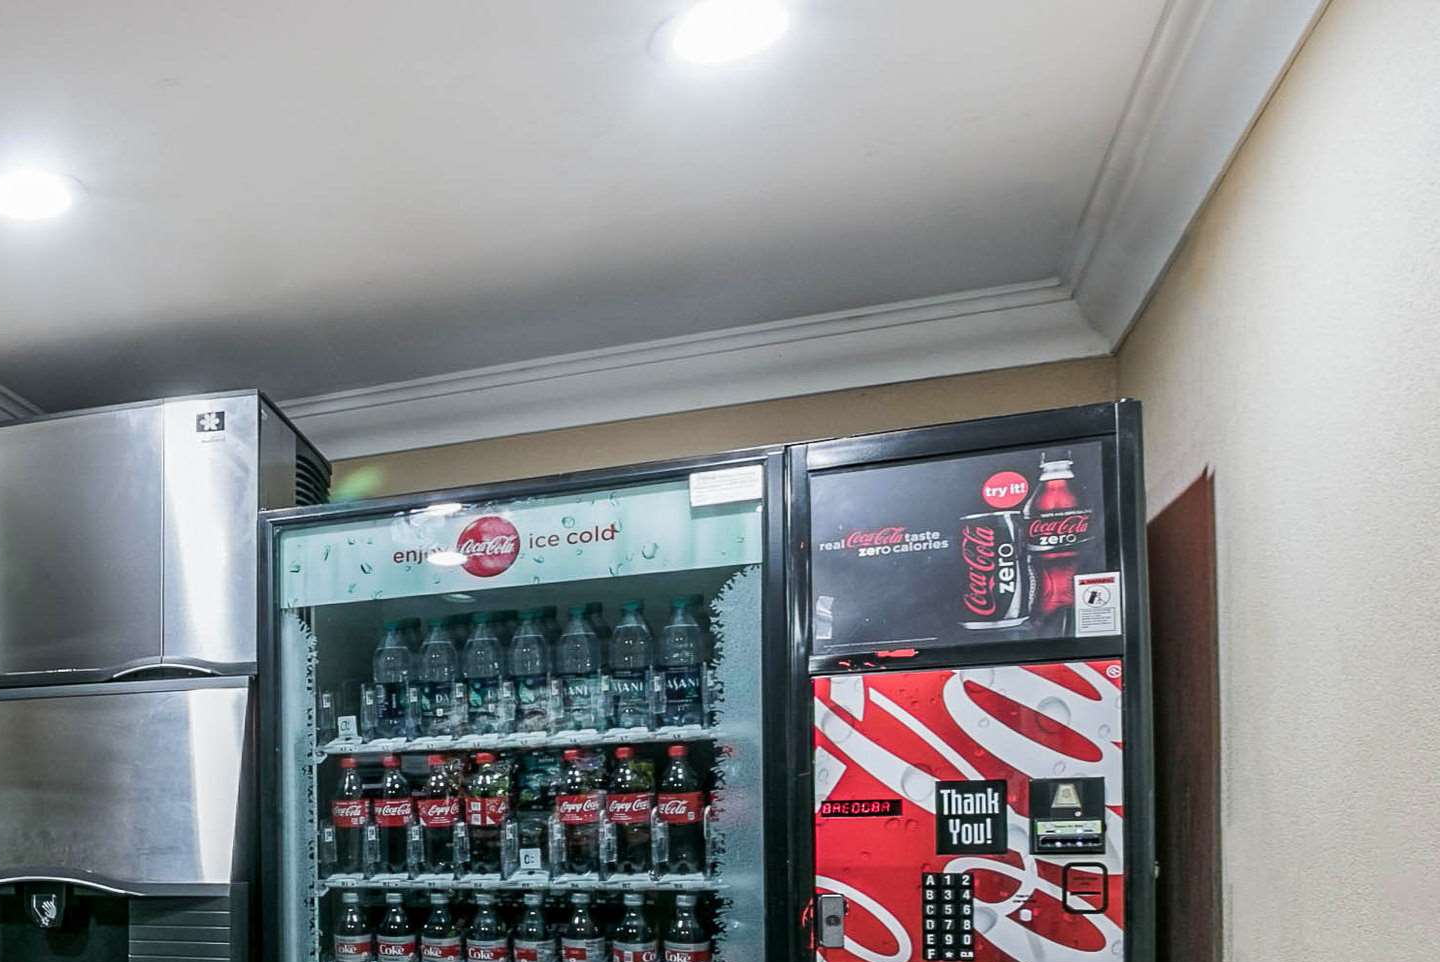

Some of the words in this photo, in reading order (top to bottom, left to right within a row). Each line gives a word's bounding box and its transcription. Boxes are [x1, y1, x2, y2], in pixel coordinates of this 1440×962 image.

[984, 485, 1008, 498] try
[1010, 482, 1025, 494] it!
[1029, 515, 1089, 537] Coca-Cola
[529, 533, 559, 549] ice
[566, 524, 618, 545] cold
[819, 539, 845, 551] real
[847, 527, 906, 548] Coca-Cola
[904, 531, 940, 543] taste
[1040, 533, 1077, 546] zero
[858, 544, 892, 557] zero
[893, 539, 949, 553] calories
[962, 527, 996, 616] Coca-Cola
[998, 543, 1014, 594] zero
[940, 787, 999, 815] Thank
[949, 817, 992, 845] You!
[926, 874, 935, 886] A
[944, 874, 951, 886] 1
[962, 874, 970, 886] 2
[926, 889, 934, 900] B
[944, 889, 952, 900] 3
[962, 889, 971, 900] 4
[926, 904, 934, 915] C
[944, 904, 952, 915] 5
[963, 904, 971, 915] 6
[926, 919, 935, 930] D
[944, 919, 953, 930] 7
[963, 919, 971, 930] 8
[926, 934, 936, 945] E
[944, 934, 953, 945] 9
[963, 934, 971, 945] 0
[338, 944, 357, 954] oke
[927, 948, 936, 960] F
